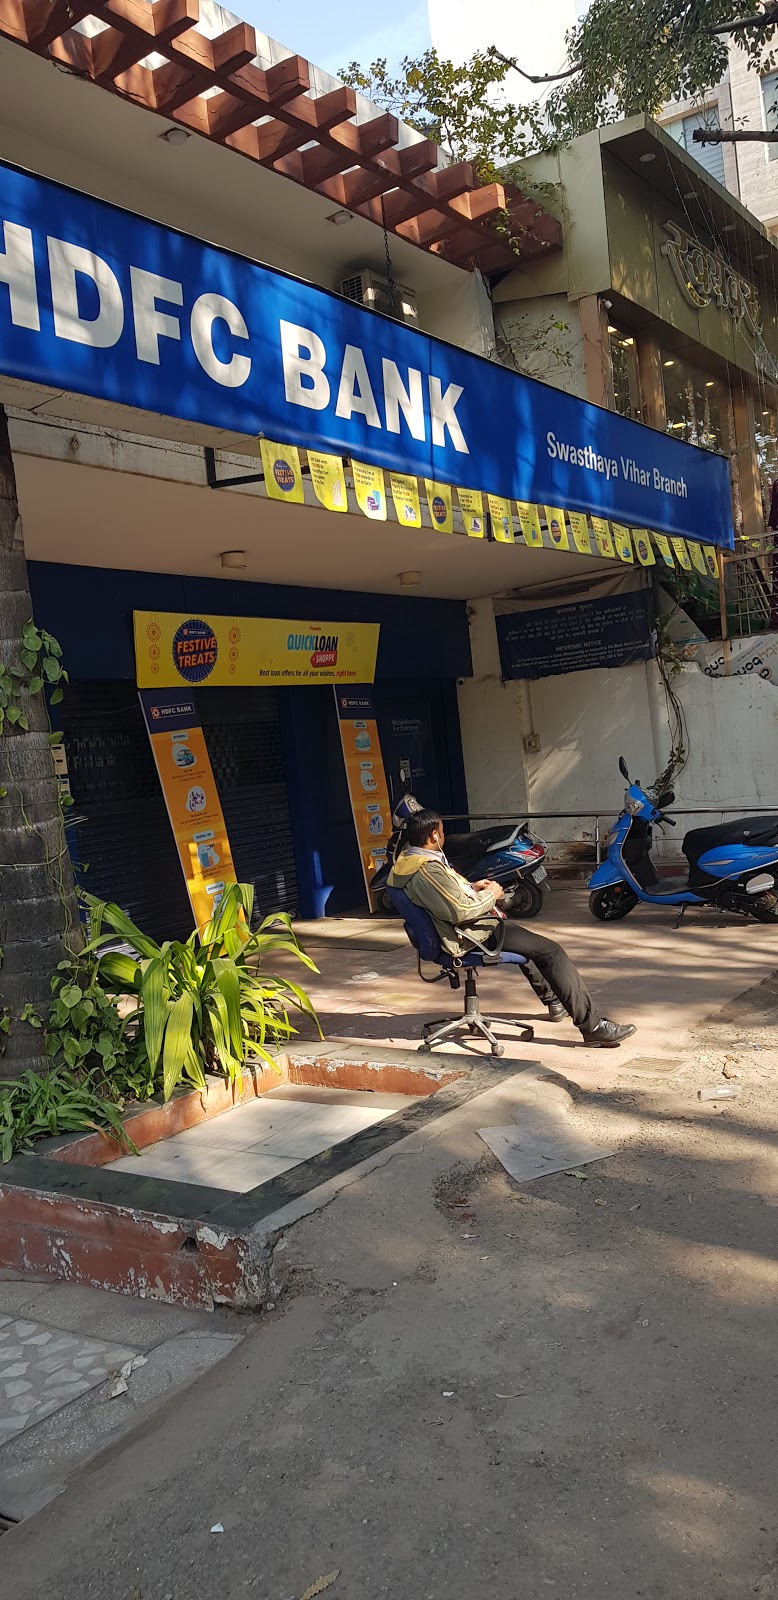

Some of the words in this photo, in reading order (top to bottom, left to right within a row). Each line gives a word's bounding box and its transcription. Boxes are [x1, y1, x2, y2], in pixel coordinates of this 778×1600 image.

[0, 220, 251, 388] HDFC
[279, 319, 470, 454] BANK
[546, 431, 618, 480] Swasthaya
[620, 456, 651, 487] Vihar
[653, 468, 688, 498] Branch
[274, 468, 294, 477] FESTIVE
[276, 476, 294, 484] TREATS
[177, 636, 217, 654] FESTIVE
[556, 642, 583, 652] IMPORTANT
[583, 639, 602, 648] NOTICE
[178, 651, 215, 668] TREATS
[315, 653, 335, 663] SHOPPE
[270, 669, 281, 677] loan
[281, 669, 295, 677] offers
[336, 669, 347, 678] right
[160, 706, 176, 715] HDFC
[176, 704, 193, 713] BANK
